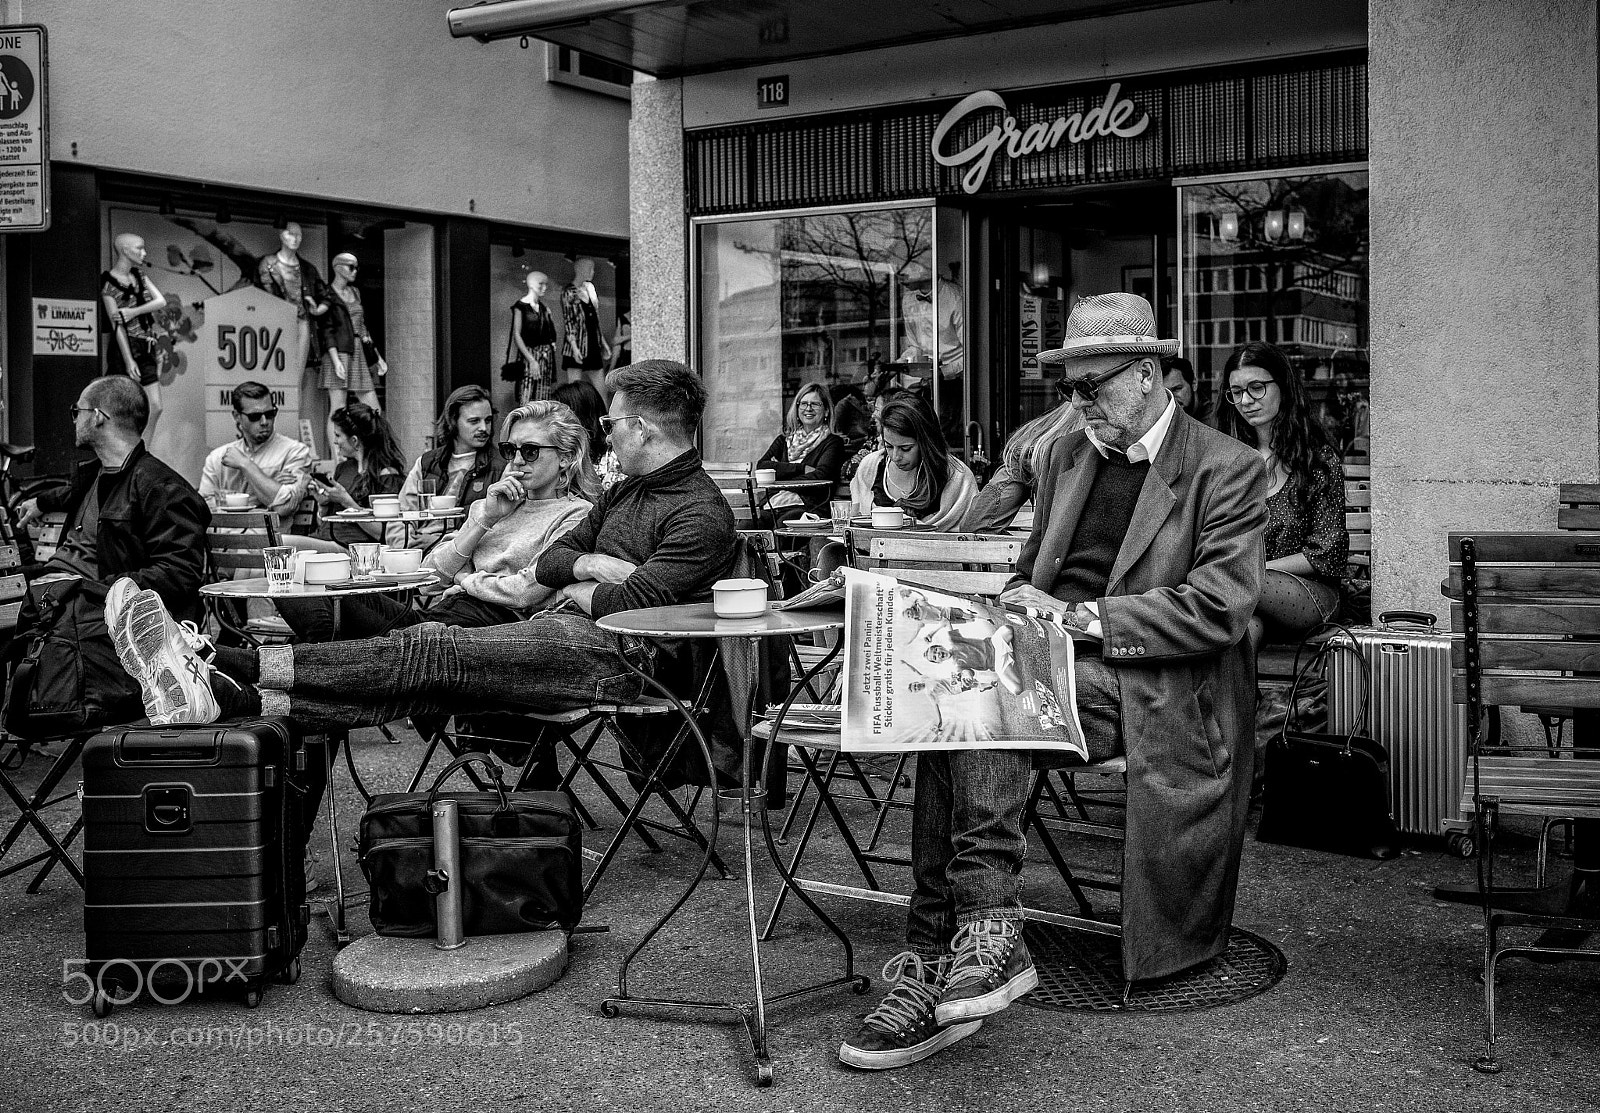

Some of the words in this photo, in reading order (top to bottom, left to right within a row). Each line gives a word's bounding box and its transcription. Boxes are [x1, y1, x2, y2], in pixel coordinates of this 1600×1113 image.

[761, 82, 784, 102] 118
[931, 82, 1149, 194] Grande
[52, 310, 86, 320] LIMMAT
[217, 324, 286, 371] 50%
[1021, 319, 1039, 369] BEANS
[885, 587, 894, 625] Kunden.
[863, 620, 873, 648] Panini
[885, 626, 894, 652] jeden
[863, 650, 872, 671] zwei
[884, 653, 893, 667] für
[862, 672, 871, 695] Jetzt
[884, 668, 895, 695] gratis
[873, 714, 882, 734] FIFA
[884, 696, 893, 728] Sticker
